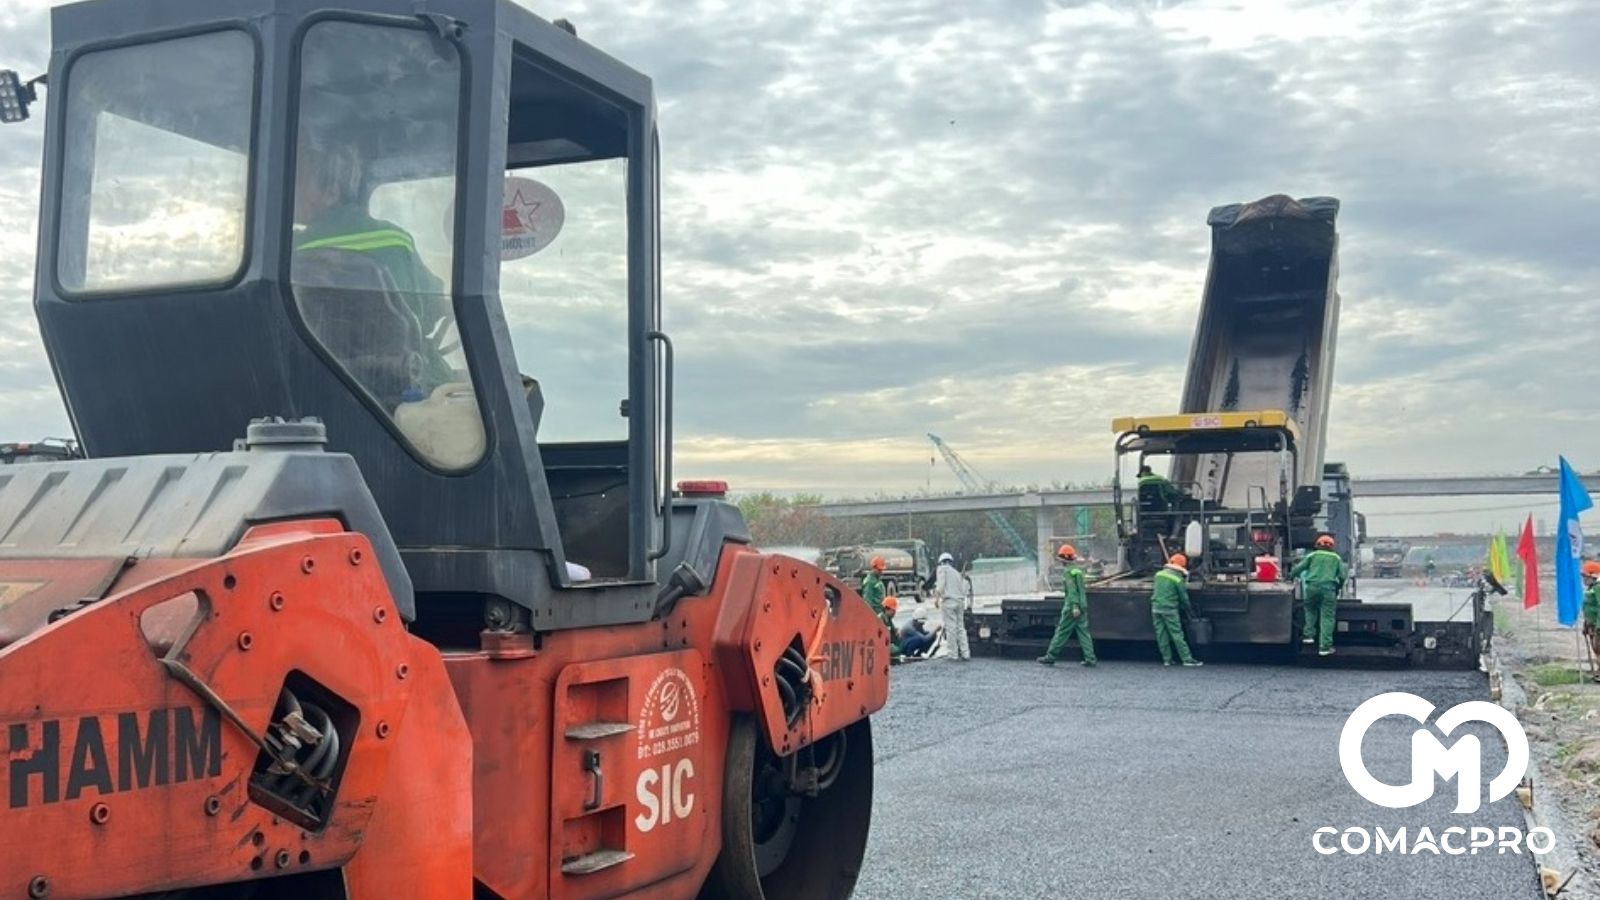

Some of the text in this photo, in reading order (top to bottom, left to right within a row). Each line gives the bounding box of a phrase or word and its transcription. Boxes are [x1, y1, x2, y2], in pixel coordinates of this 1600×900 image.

[821, 638, 875, 682] GRW 18
[9, 706, 222, 809] HAMM
[635, 758, 694, 832] SIC
